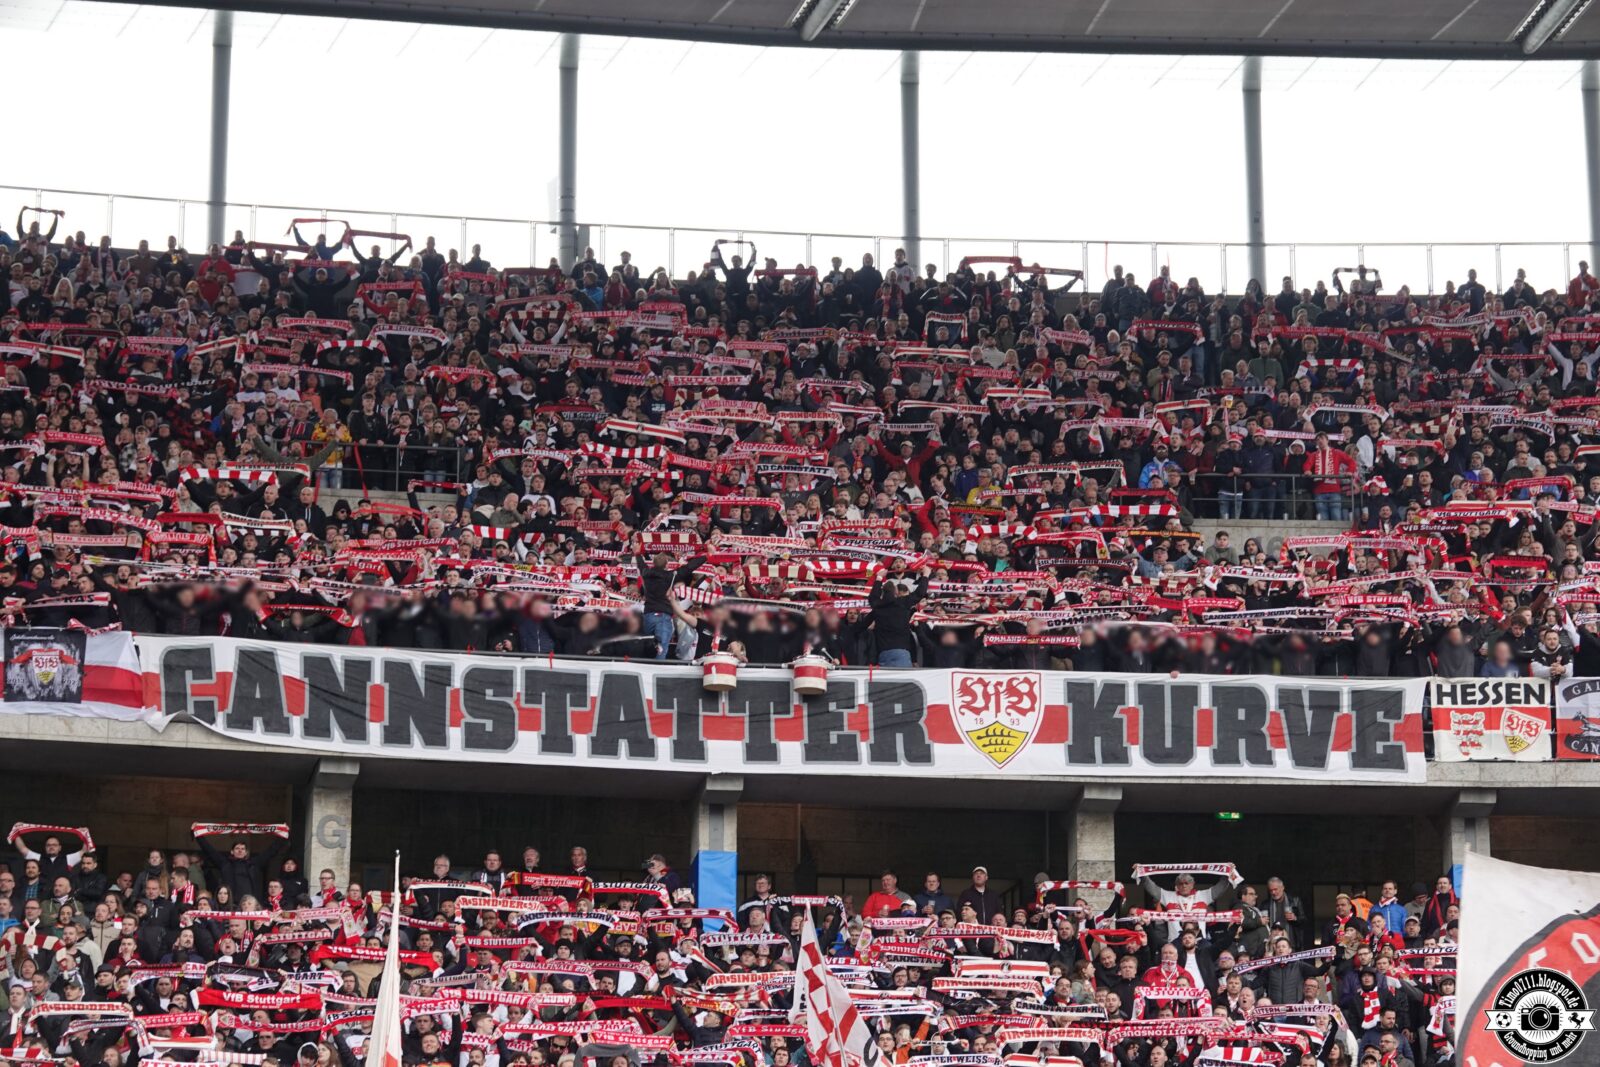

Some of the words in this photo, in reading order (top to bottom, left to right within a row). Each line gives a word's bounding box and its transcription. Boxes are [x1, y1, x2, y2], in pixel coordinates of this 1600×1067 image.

[955, 676, 1038, 718] VfB
[1436, 681, 1546, 706] HESSEN
[159, 643, 935, 767] CANNSTATTER
[1064, 678, 1408, 773] KURVE
[974, 717, 985, 725] 18
[1009, 718, 1020, 726] 93
[316, 814, 348, 850] G
[468, 938, 481, 947] VfB
[483, 937, 528, 947] STUTTGART
[708, 932, 776, 944] STUTTGART
[824, 956, 847, 967] VfB
[729, 973, 757, 983] SIND
[222, 991, 244, 1002] VfB
[246, 993, 301, 1005] Stuttgart
[443, 988, 461, 1000] VfB
[465, 988, 528, 1006] STUTTGART
[596, 1033, 614, 1042] VfB
[619, 1035, 671, 1046] Stuttgart
[956, 1054, 989, 1064] WEISS
